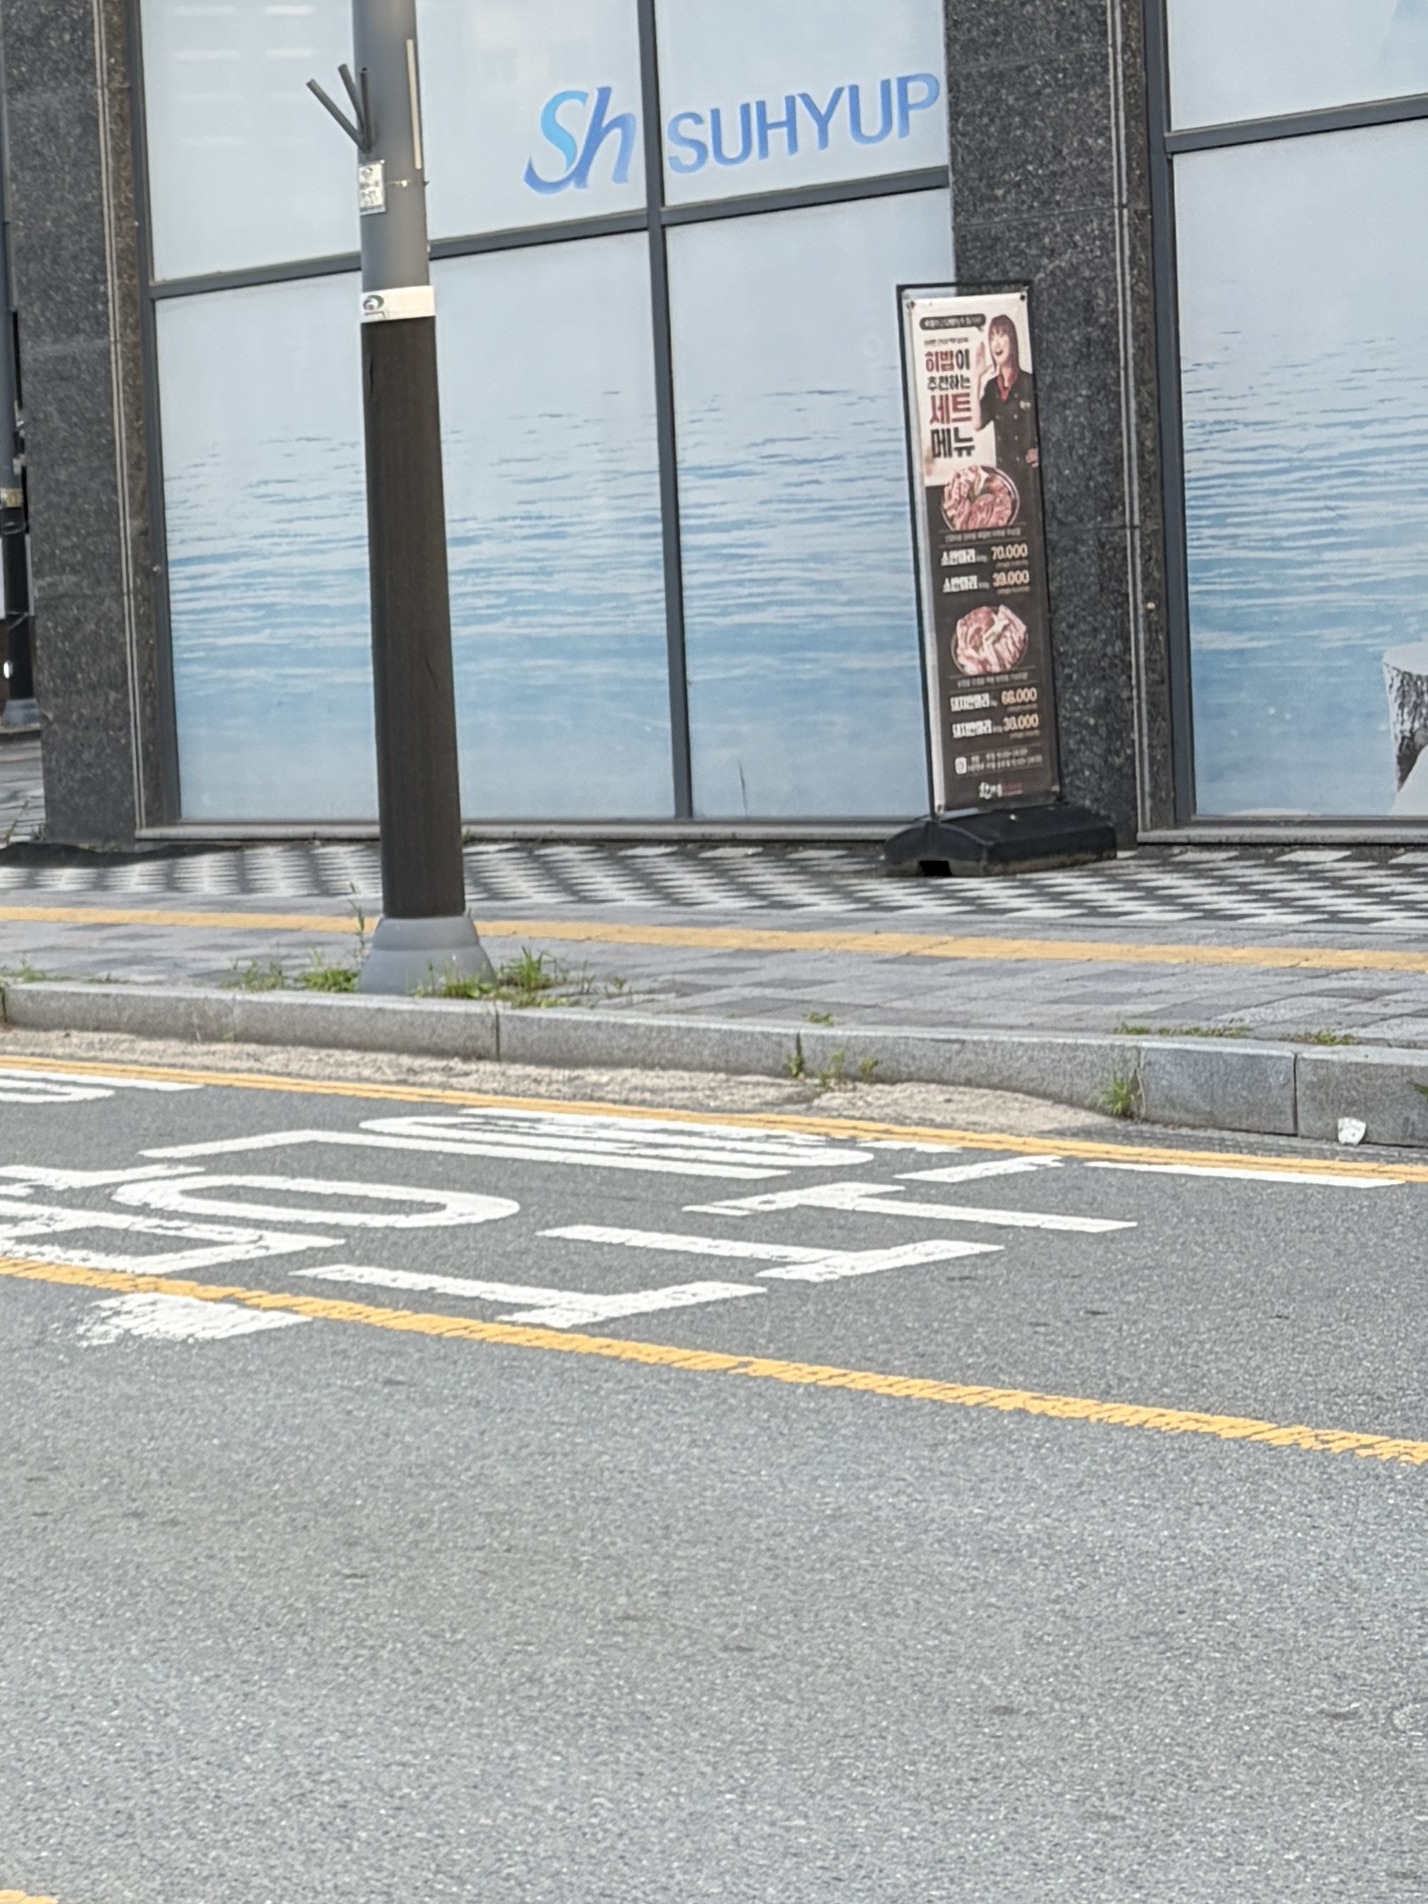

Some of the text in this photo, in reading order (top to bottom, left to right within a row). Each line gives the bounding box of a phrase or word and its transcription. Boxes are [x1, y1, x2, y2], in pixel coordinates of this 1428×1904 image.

[523, 72, 941, 195] Sh SUHYUP
[929, 393, 973, 425] 세트
[930, 427, 976, 459] 메뉴
